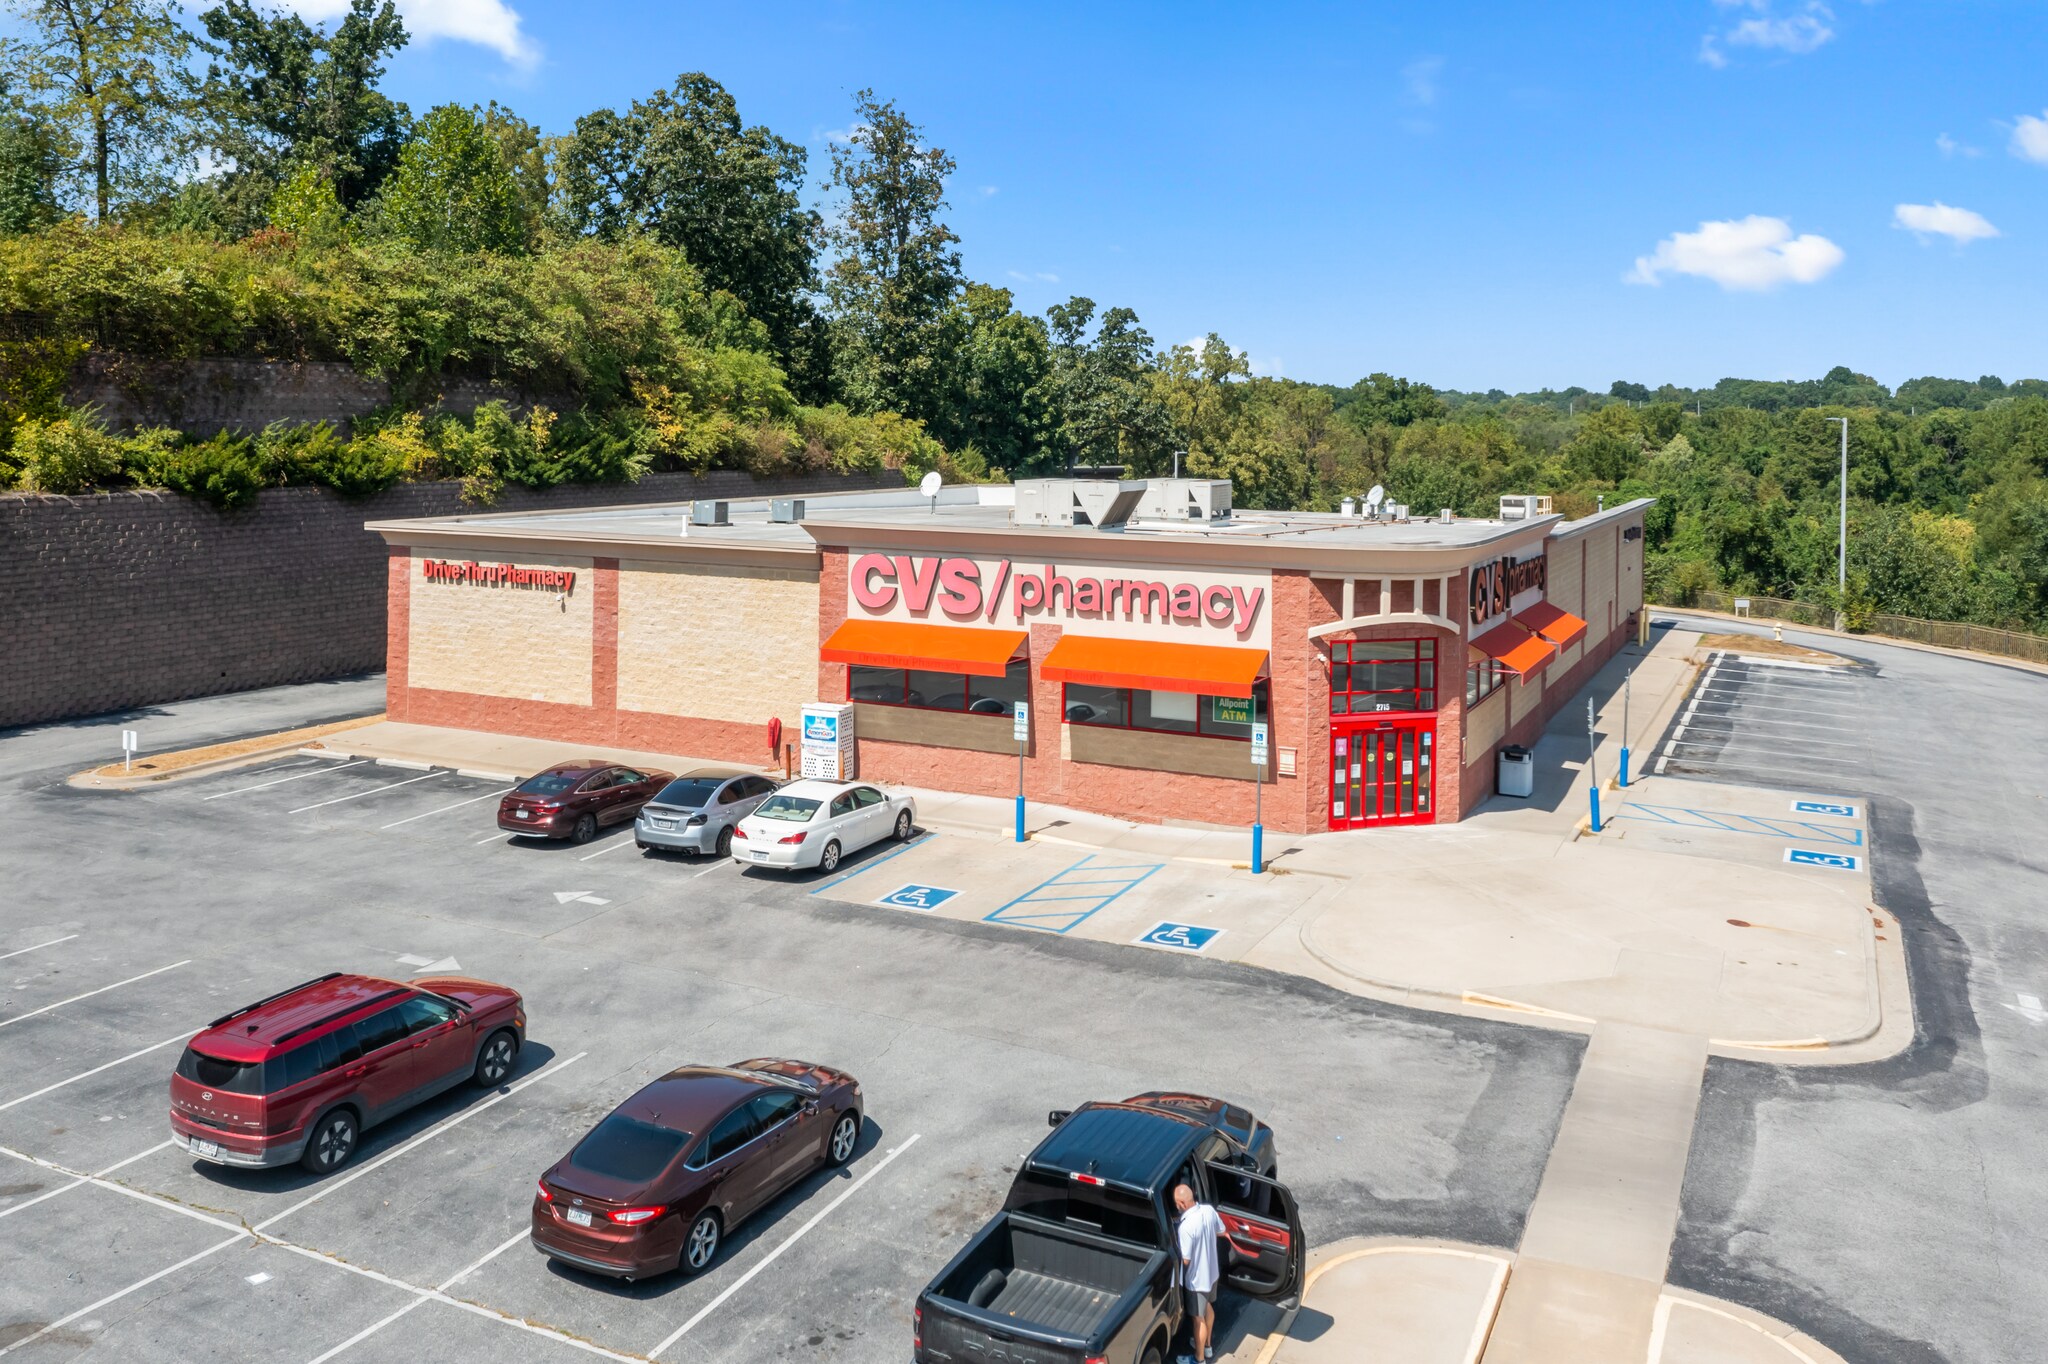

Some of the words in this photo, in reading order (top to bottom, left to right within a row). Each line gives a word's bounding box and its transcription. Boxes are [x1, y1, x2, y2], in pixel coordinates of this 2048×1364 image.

[423, 559, 496, 582] Drive-Thru
[498, 563, 576, 591] Pharmacy
[850, 552, 1264, 633] CVS/pharmacy
[1219, 698, 1249, 709] Allpoint
[1376, 703, 1390, 711] 2715
[1222, 710, 1247, 721] ATM
[180, 1101, 215, 1115] SANTA
